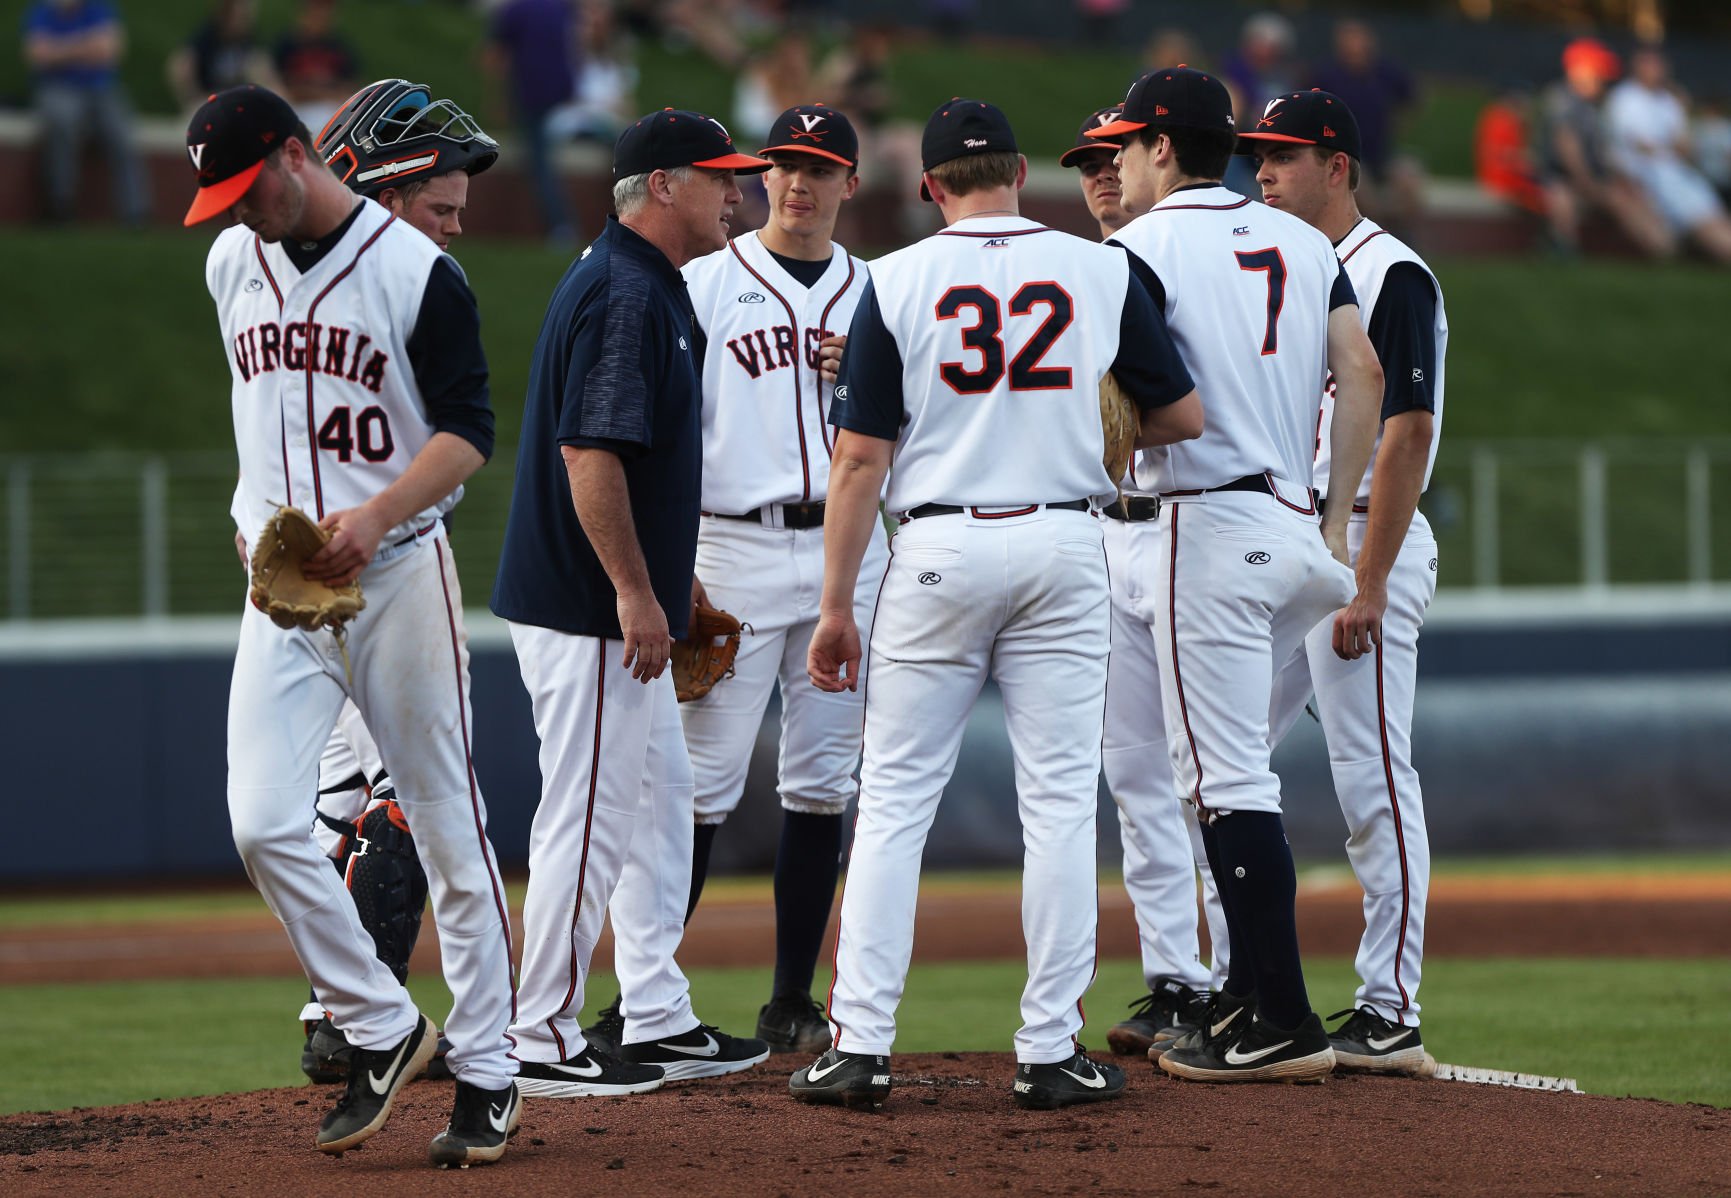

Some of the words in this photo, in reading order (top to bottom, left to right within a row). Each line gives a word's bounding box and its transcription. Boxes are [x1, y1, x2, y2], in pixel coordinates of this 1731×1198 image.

[800, 114, 826, 133] V
[982, 238, 1010, 248] ACC
[1234, 246, 1287, 356] 7
[935, 280, 1074, 395] 32
[234, 321, 388, 393] VIRGINIA
[317, 405, 395, 463] 40
[871, 1074, 890, 1085] NIKE
[1013, 1080, 1034, 1094] NIKE
